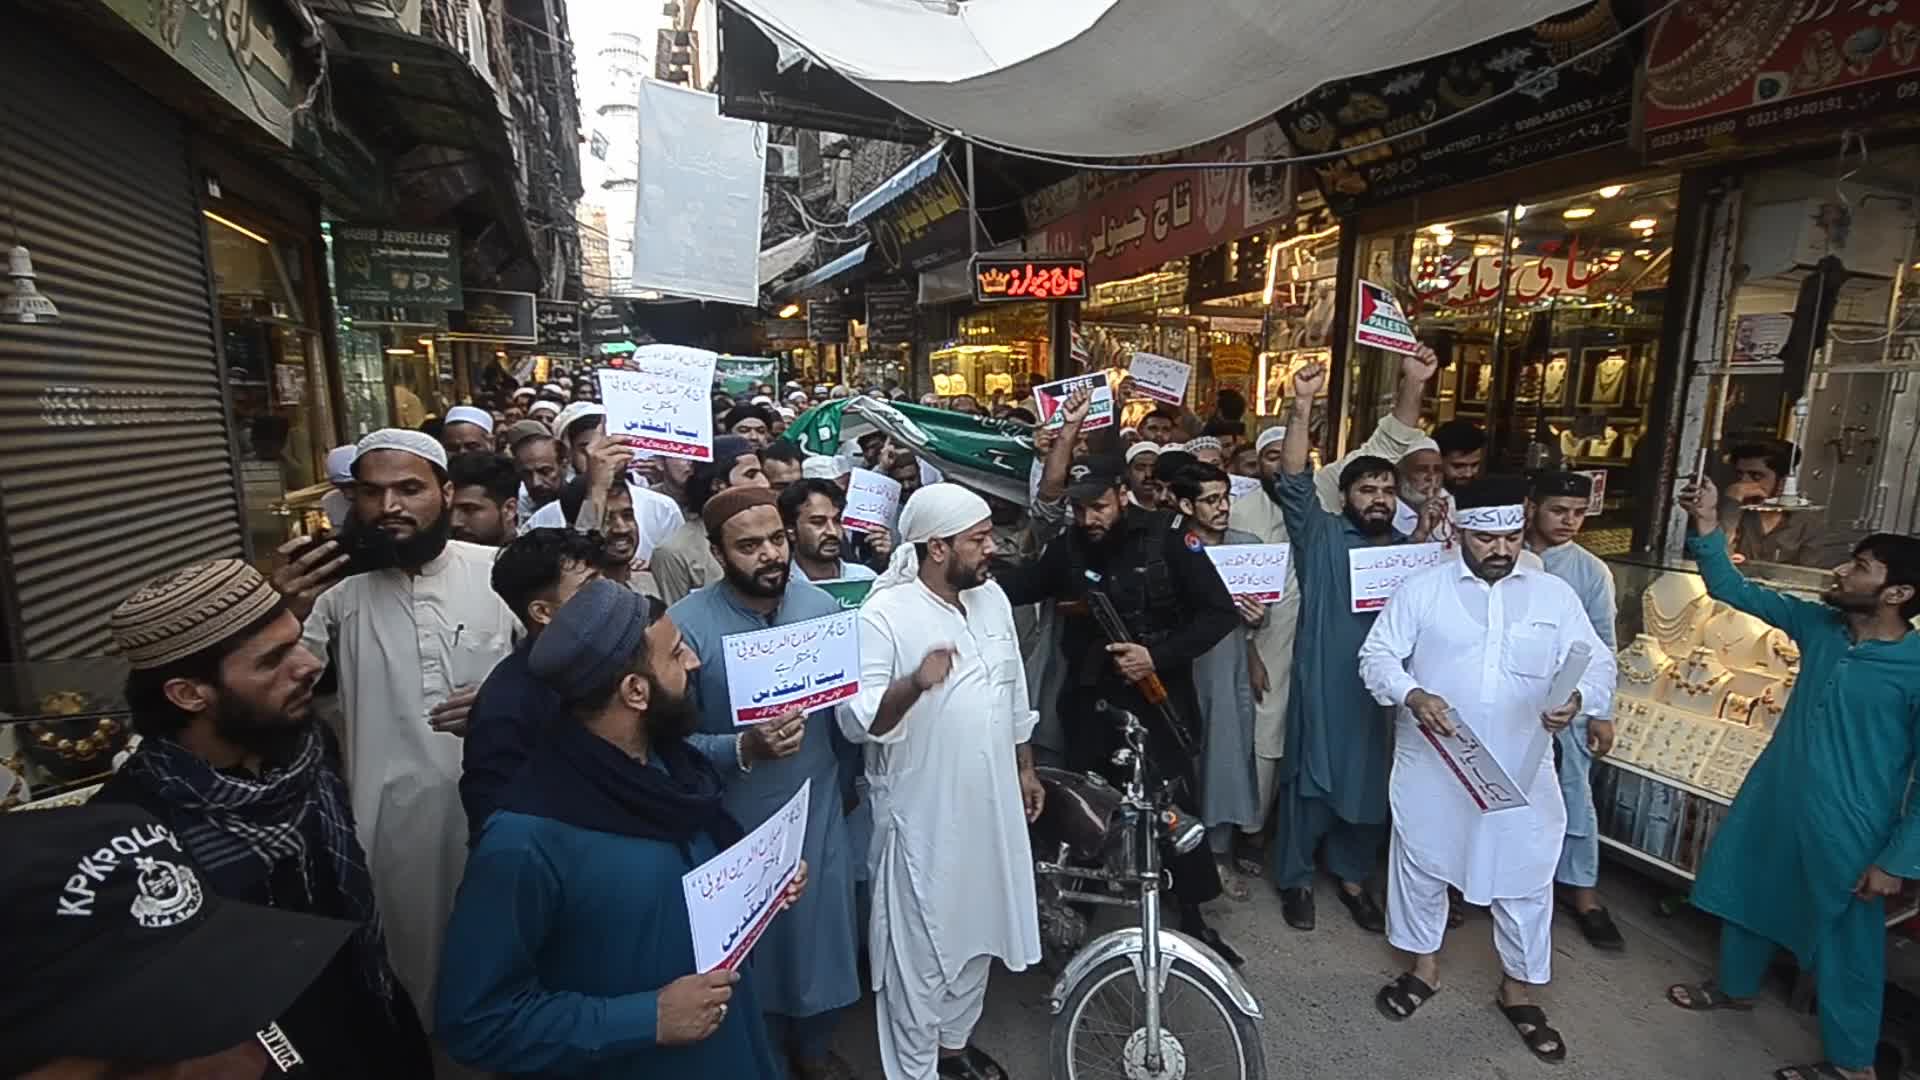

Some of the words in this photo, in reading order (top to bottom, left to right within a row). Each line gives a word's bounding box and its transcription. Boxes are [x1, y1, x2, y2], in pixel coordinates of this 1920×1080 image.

[1152, 180, 1192, 242] تاج
[382, 230, 451, 247] JEWELLERS
[1048, 265, 1085, 296] تاج
[1061, 378, 1094, 394] FREE
[624, 419, 673, 434] المقدس
[836, 617, 853, 636] آج
[761, 634, 791, 656] الدین
[815, 668, 845, 686] بیت
[751, 674, 812, 703] المقدس
[721, 884, 773, 953] المقدس
